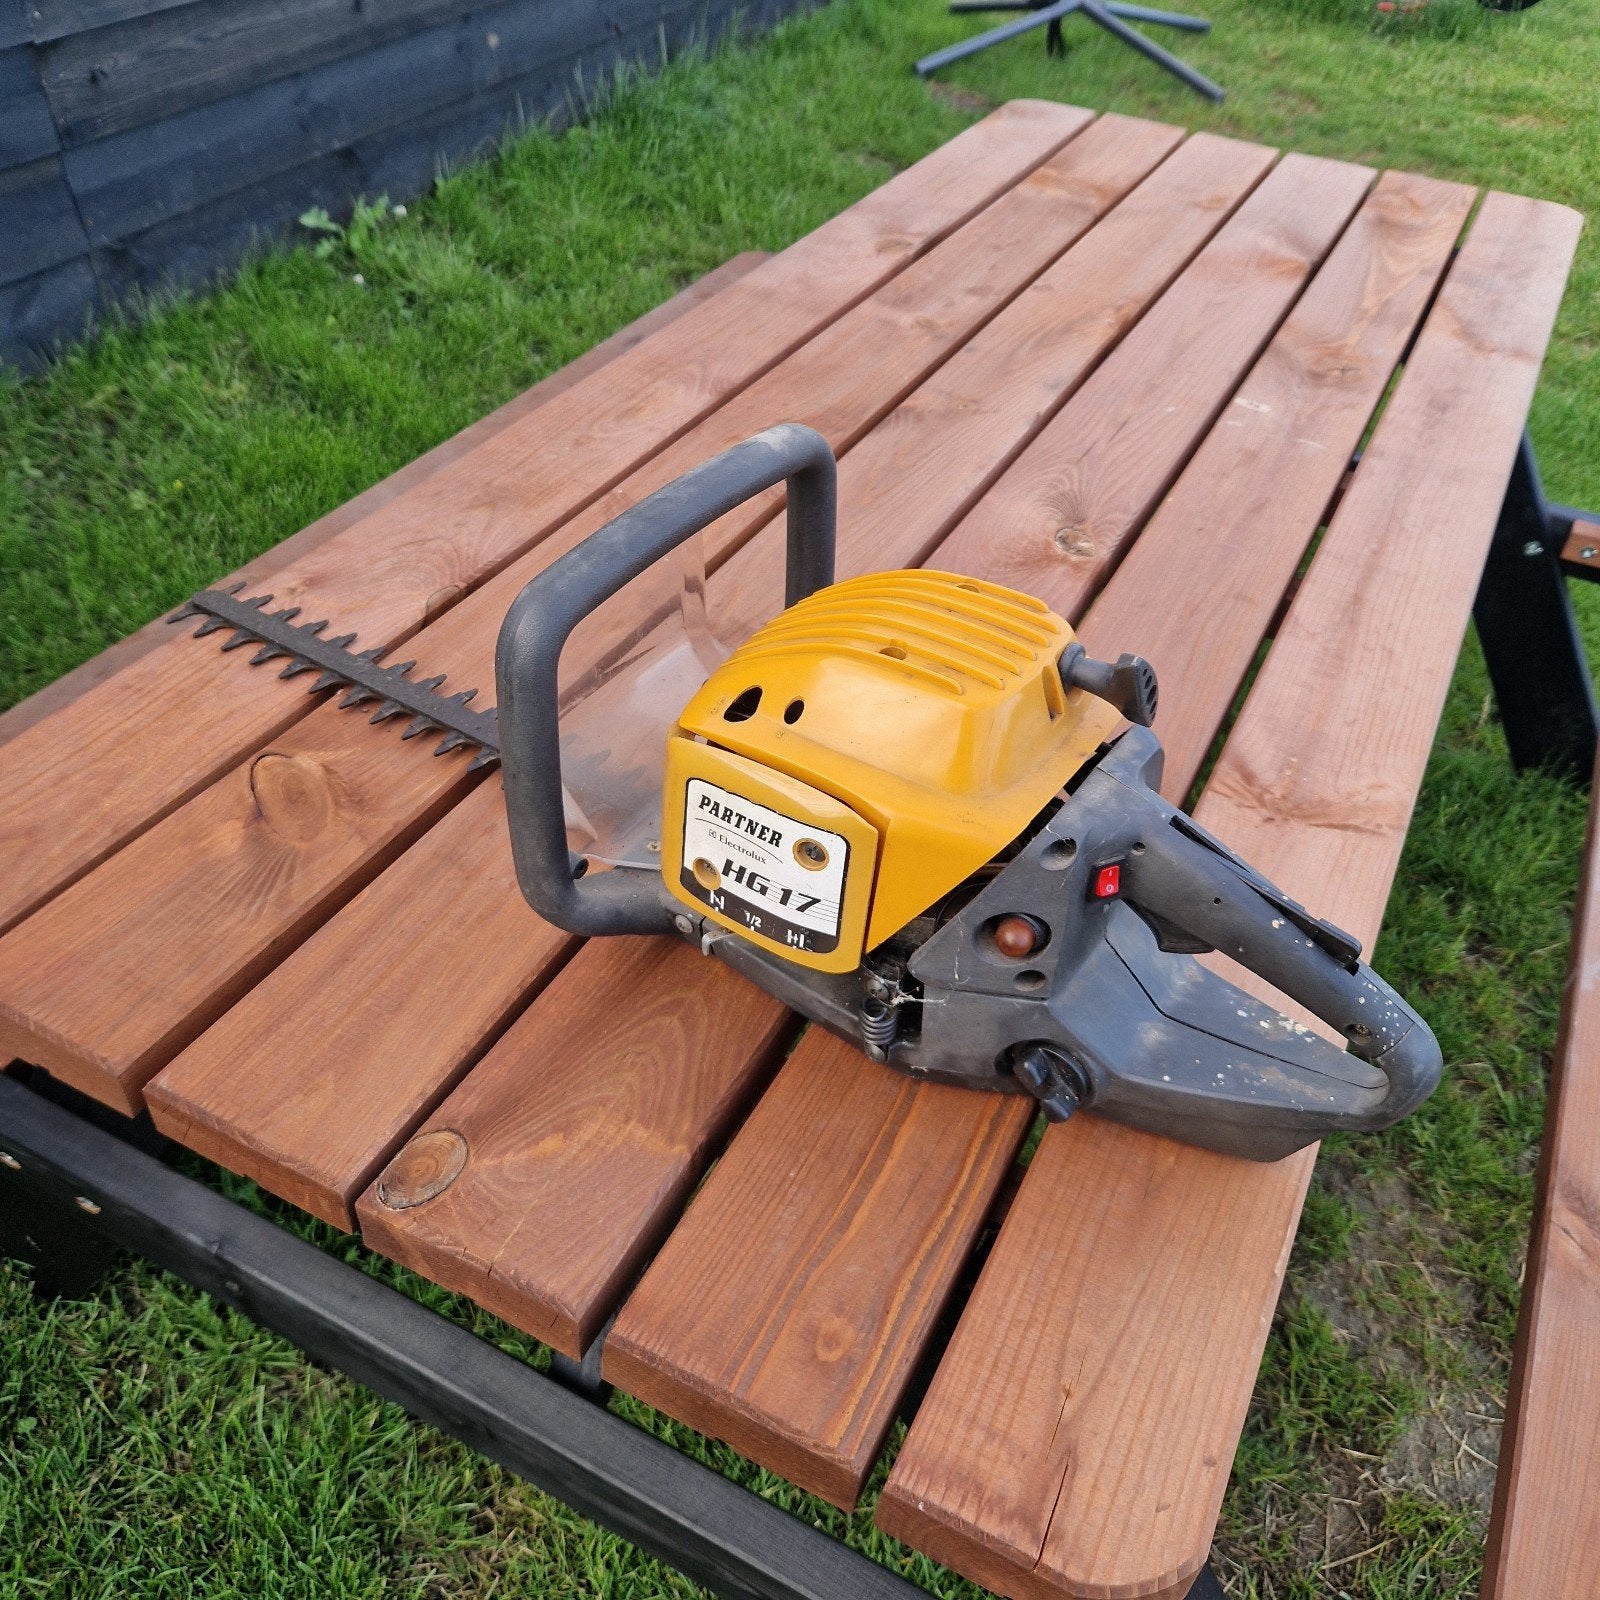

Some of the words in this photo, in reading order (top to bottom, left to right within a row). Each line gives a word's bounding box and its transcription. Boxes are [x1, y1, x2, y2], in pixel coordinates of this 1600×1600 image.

[698, 794, 783, 848] PARTNER
[719, 834, 767, 864] Electrolux
[744, 910, 762, 928] 1/2
